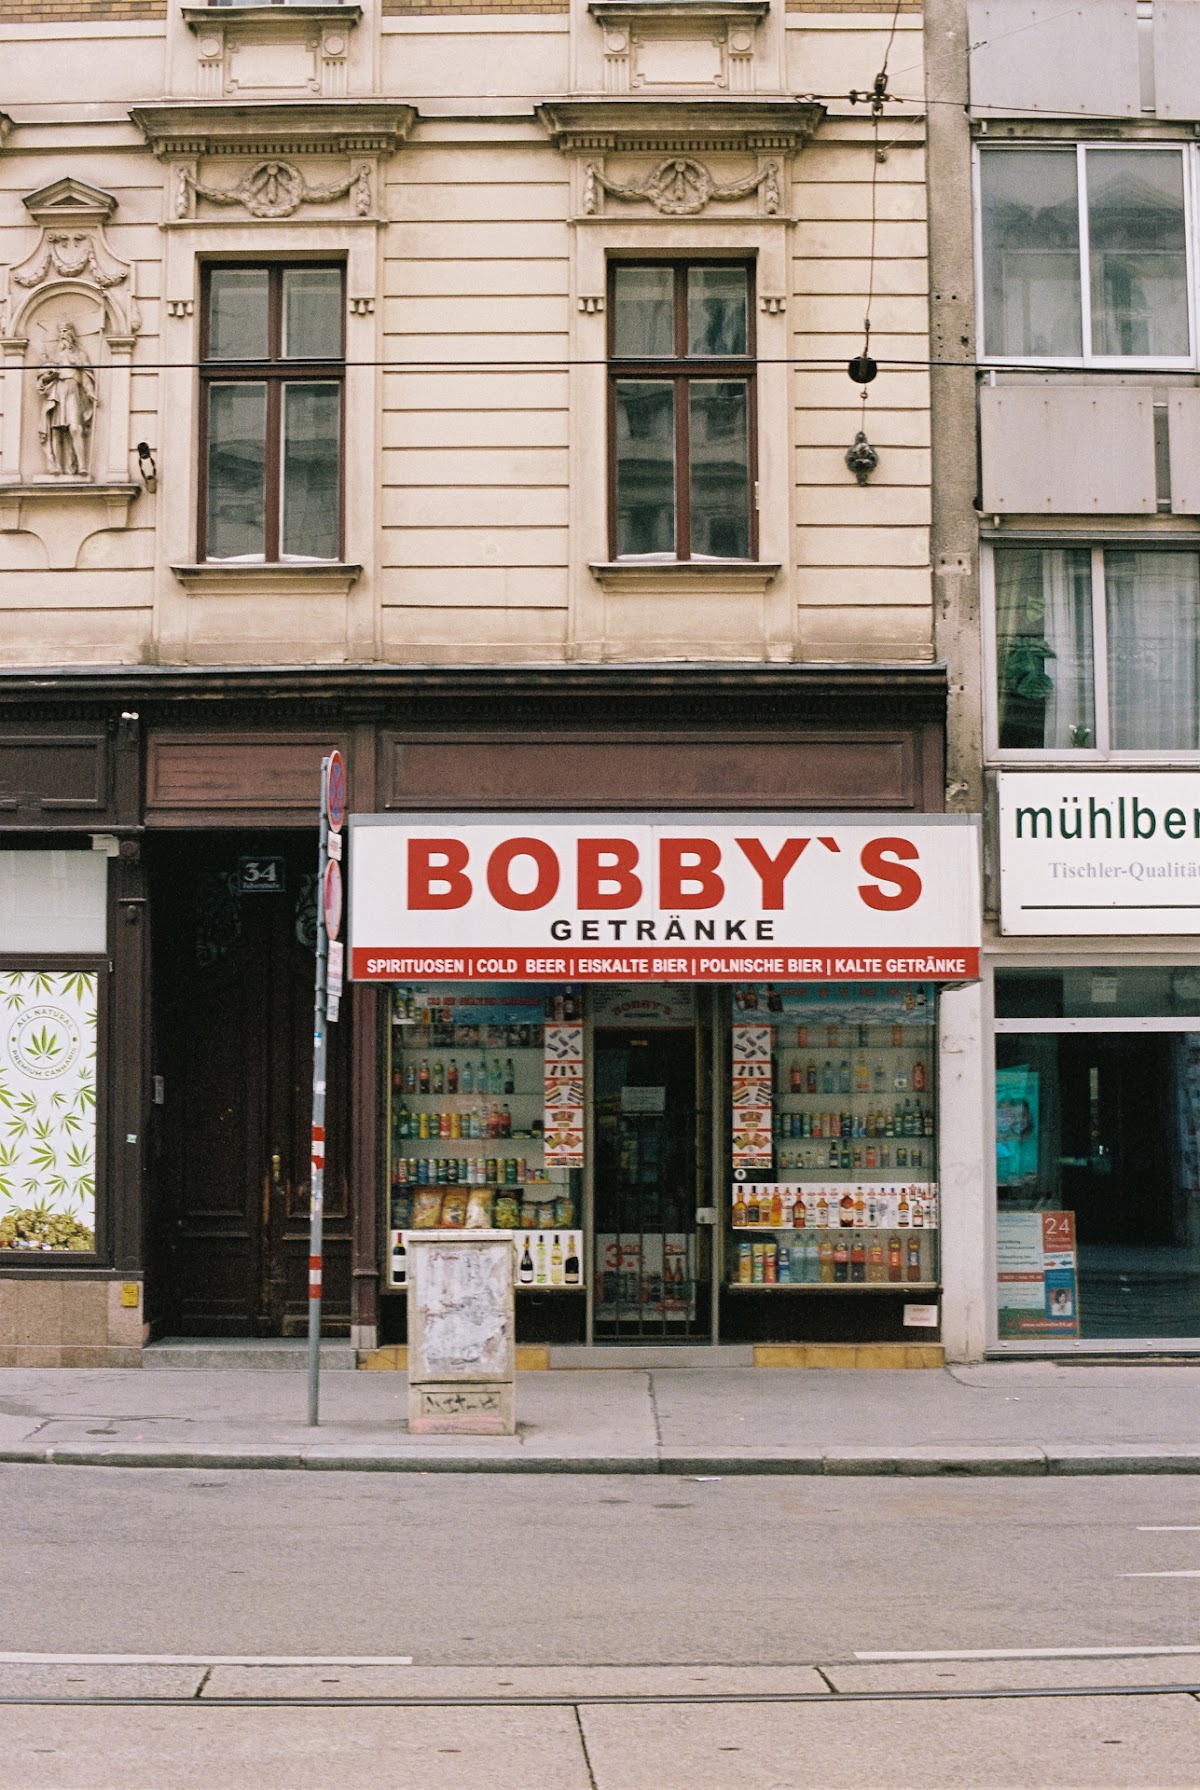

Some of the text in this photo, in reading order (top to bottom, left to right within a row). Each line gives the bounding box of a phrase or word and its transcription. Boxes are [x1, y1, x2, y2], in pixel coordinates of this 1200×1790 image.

[244, 862, 277, 882] 34
[1048, 861, 1200, 881] Tischler-Qualitä
[550, 916, 775, 941] GETRÄNKE
[367, 955, 966, 973] SPIRITUOSEN COLD BEER EISKALTE BIER POLNISCHE BIER KALTE GETRÄNKE
[17, 1014, 32, 1028] ALL
[1044, 1217, 1071, 1235] 24
